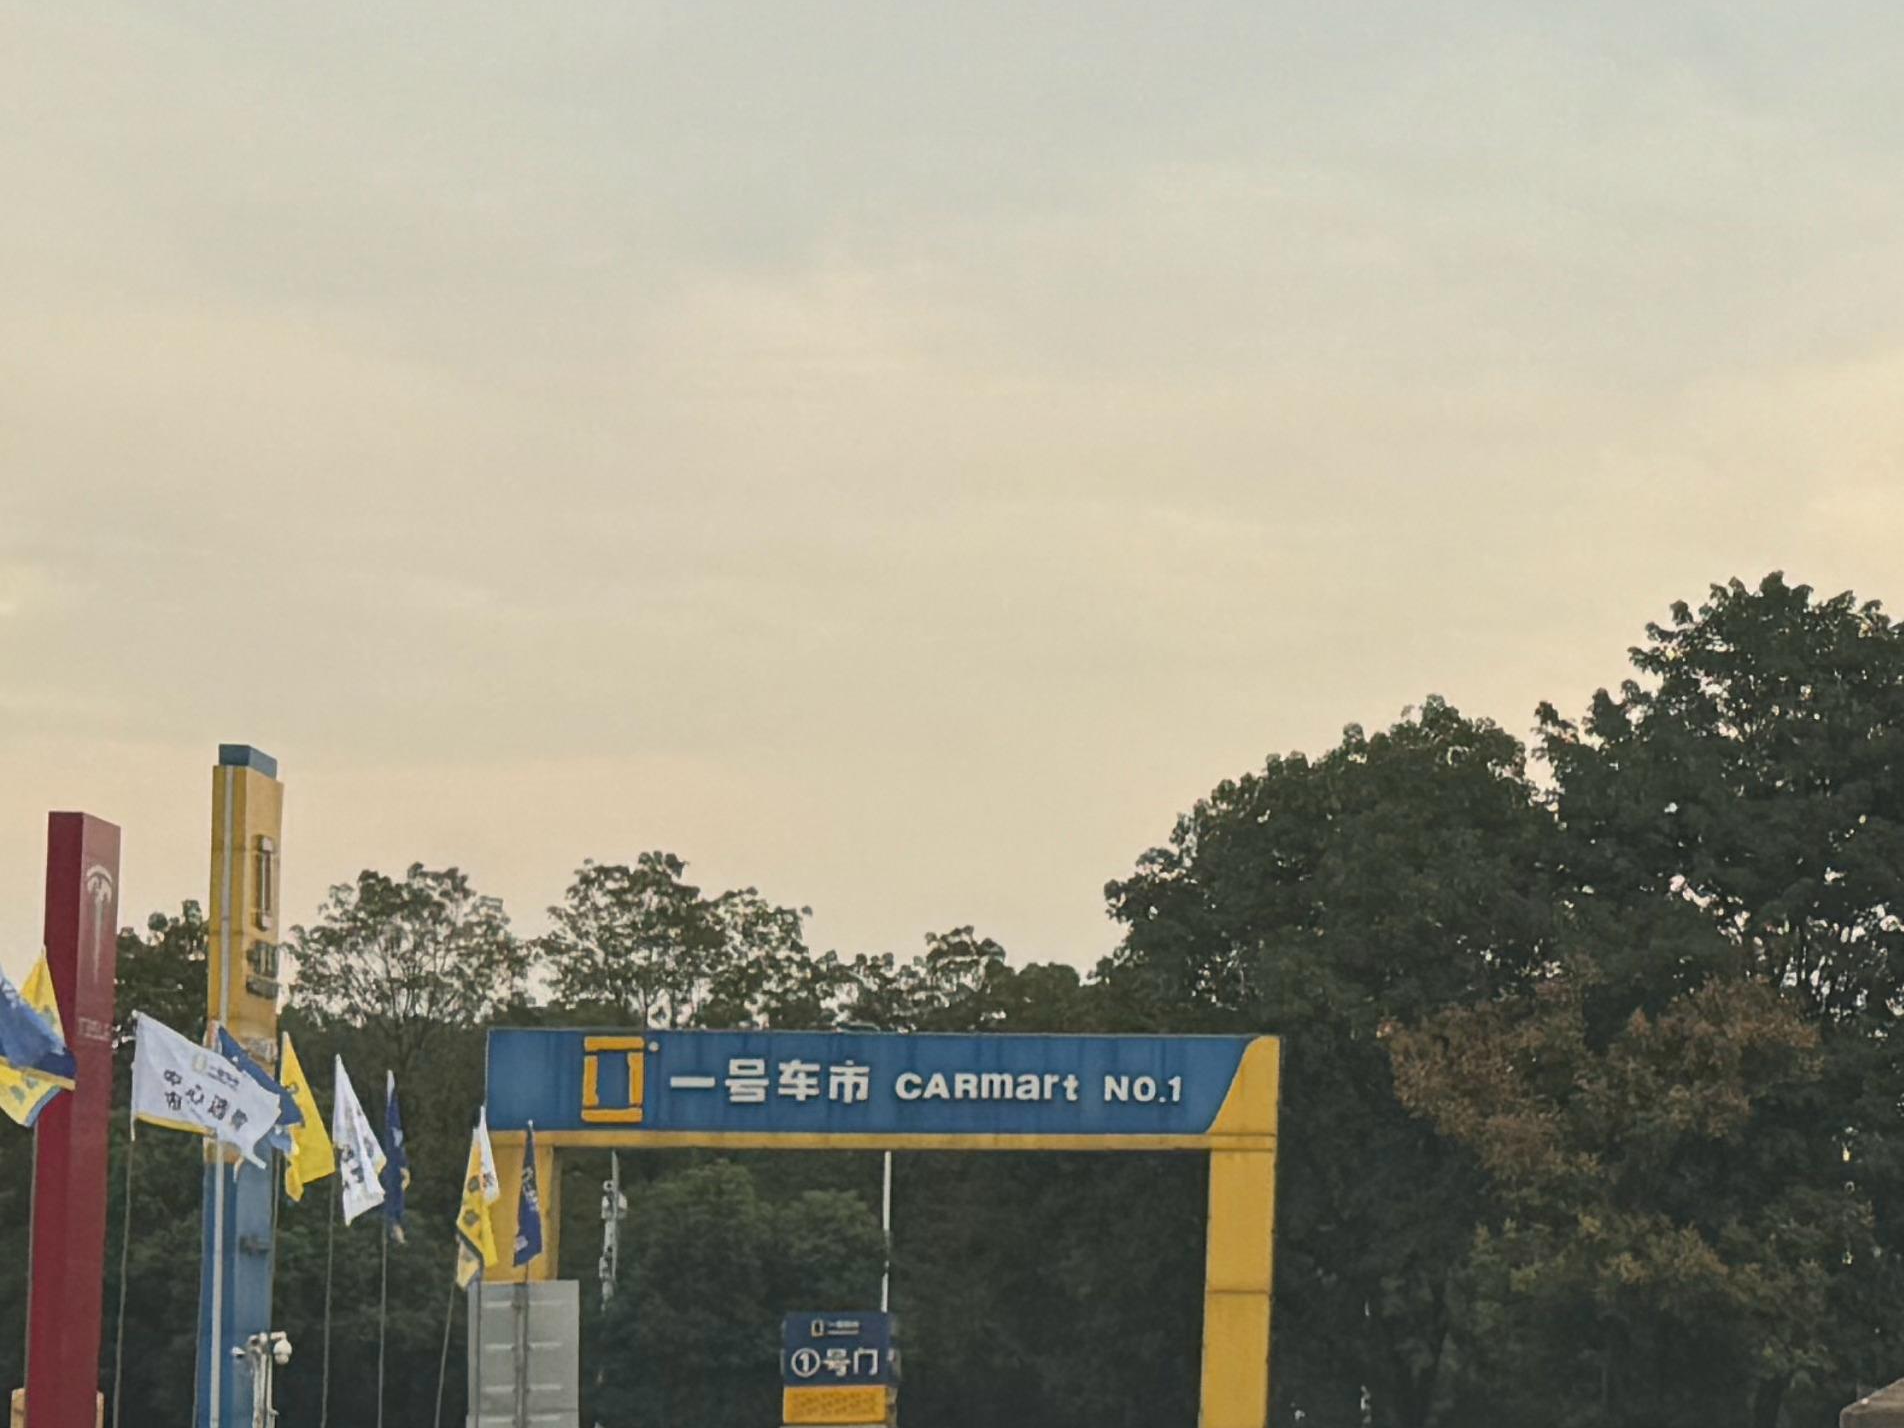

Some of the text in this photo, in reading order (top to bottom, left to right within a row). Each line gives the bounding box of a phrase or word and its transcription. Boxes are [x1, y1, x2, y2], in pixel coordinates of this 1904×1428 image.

[670, 1058, 1182, 1103] 一号车市 CARmart NO.1
